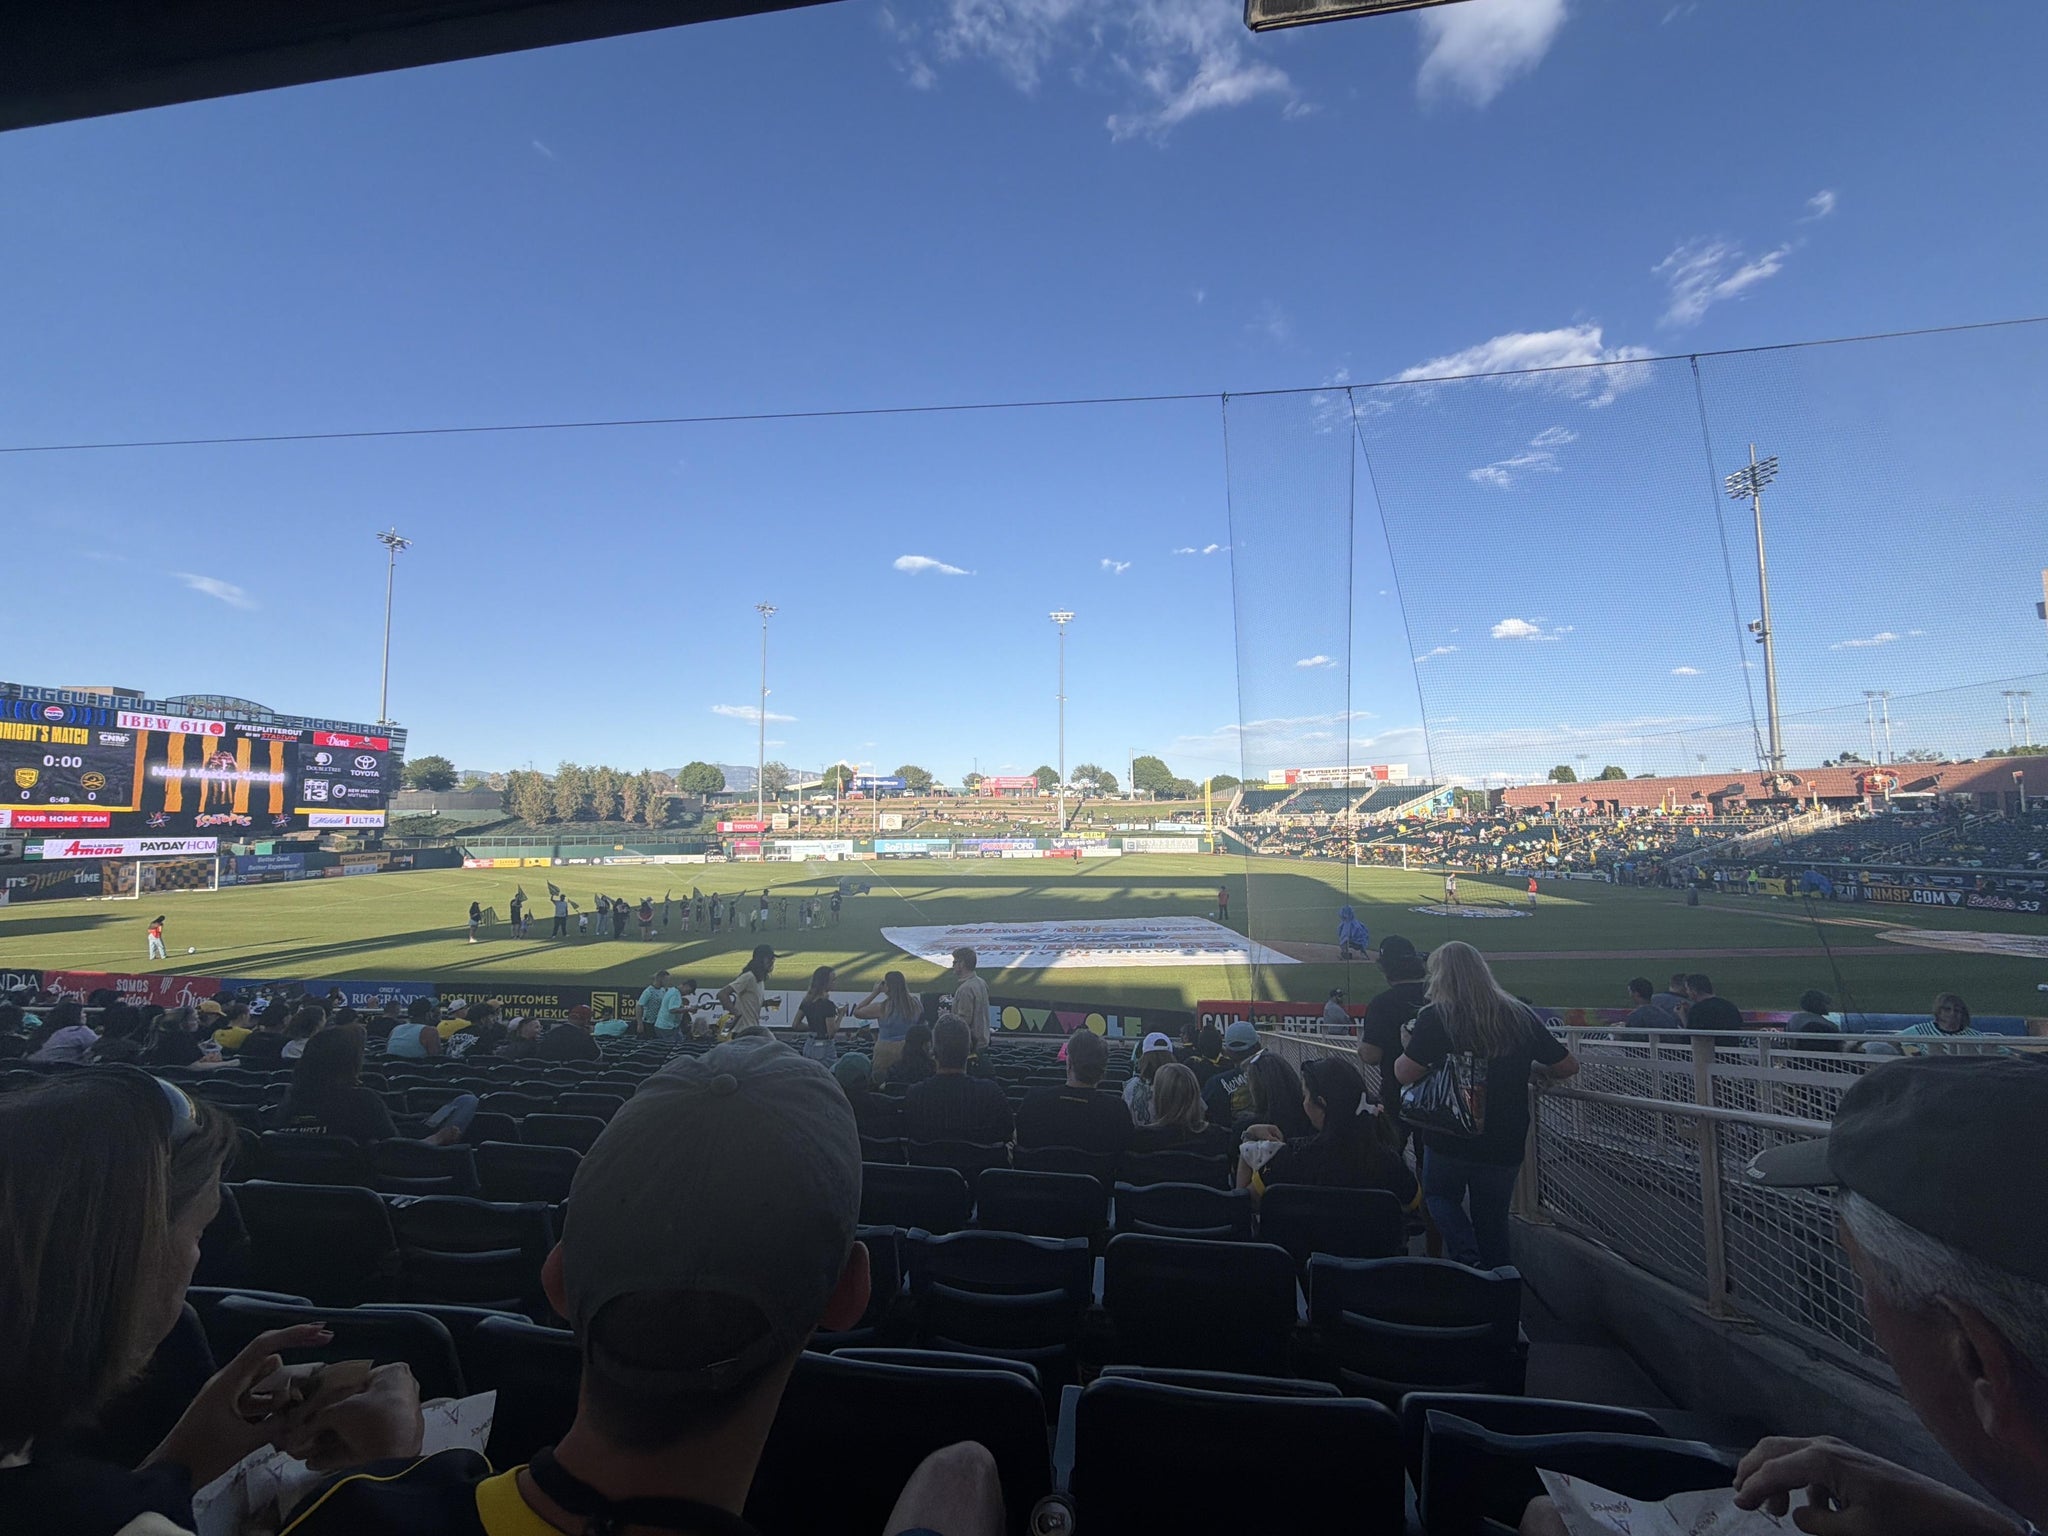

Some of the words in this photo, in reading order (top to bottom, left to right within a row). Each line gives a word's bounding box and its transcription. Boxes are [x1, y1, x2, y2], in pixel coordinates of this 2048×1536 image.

[20, 685, 87, 706] RGCU
[97, 694, 157, 713] FIELD
[121, 714, 171, 729] IBEW
[180, 722, 207, 733] 611
[302, 717, 343, 732] RGCU
[349, 722, 385, 736] FIELD
[0, 722, 49, 742] NIGHT'S
[51, 726, 89, 745] MATCH
[43, 754, 82, 768] 0:00
[151, 765, 187, 778] New
[350, 769, 379, 778] TOYOTA
[21, 790, 30, 799] 0
[88, 792, 97, 801] 0
[305, 790, 328, 800] 13
[17, 815, 46, 823] YOUR
[49, 815, 78, 823] HOME
[63, 840, 124, 856] Amana
[140, 841, 187, 851] PAYDAY
[187, 840, 216, 850] HCM
[6, 877, 28, 888] IT'S
[74, 873, 100, 884] TIME
[2017, 900, 2040, 912] 33
[116, 978, 150, 992] SOMOS
[117, 993, 153, 1005] nidos!
[440, 994, 489, 1004] POSITIV
[495, 995, 558, 1005] OUTCOMES
[505, 1009, 530, 1018] NEW
[534, 1010, 569, 1019] MEXIC
